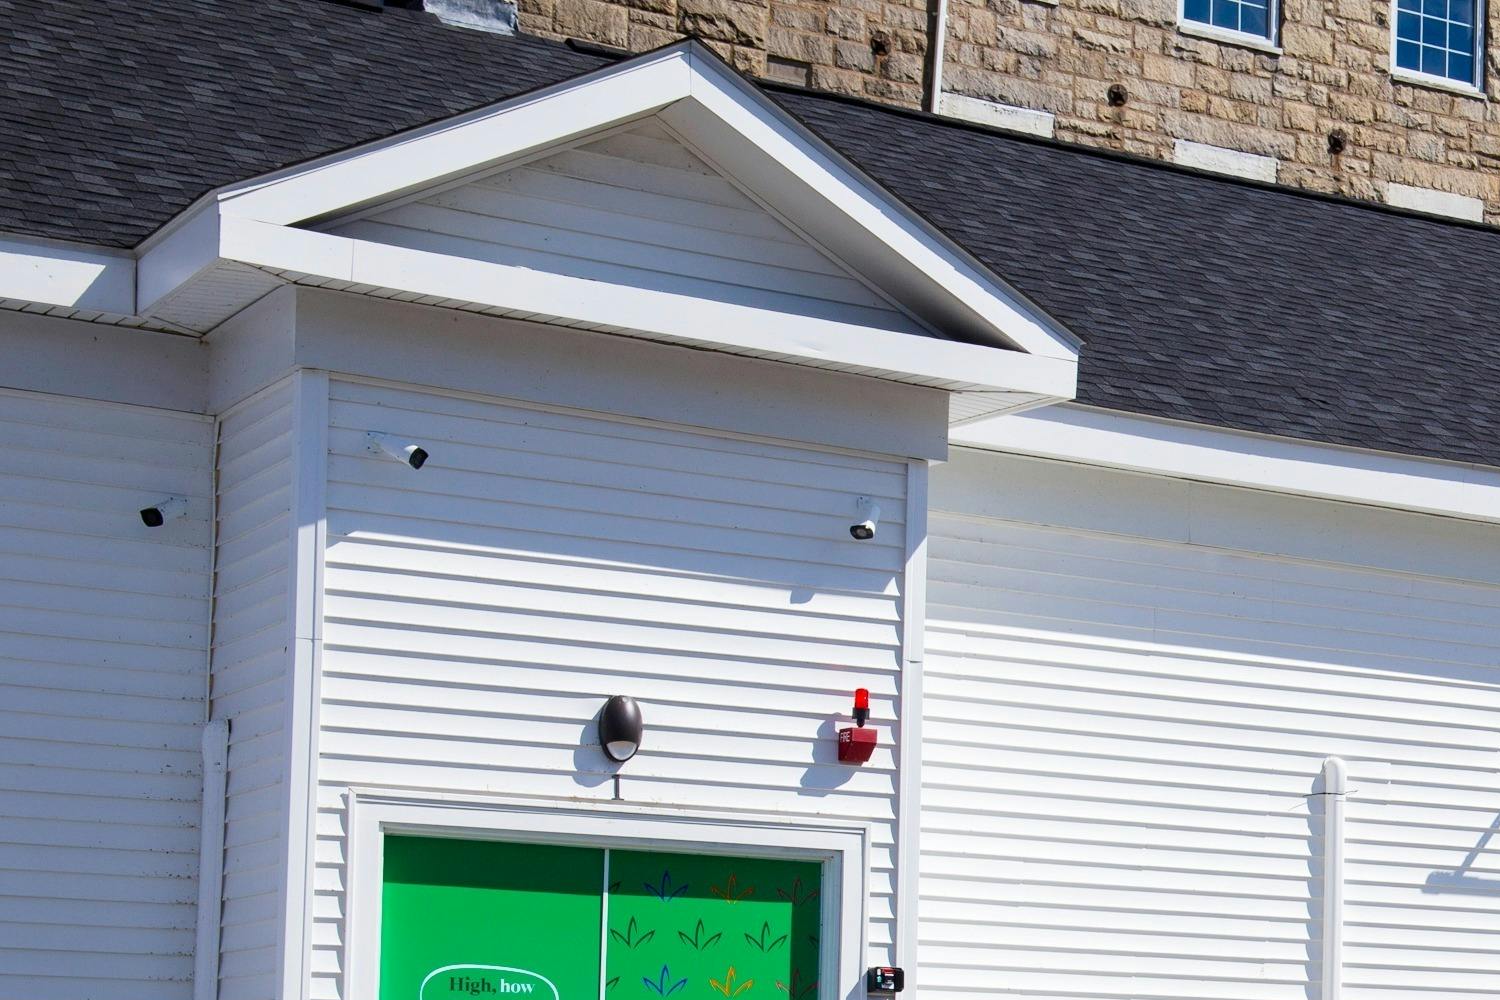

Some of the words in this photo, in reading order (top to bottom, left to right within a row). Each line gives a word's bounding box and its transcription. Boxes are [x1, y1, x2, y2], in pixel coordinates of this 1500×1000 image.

[840, 731, 851, 743] FIRE
[449, 976, 498, 995] High,
[500, 978, 536, 993] how
